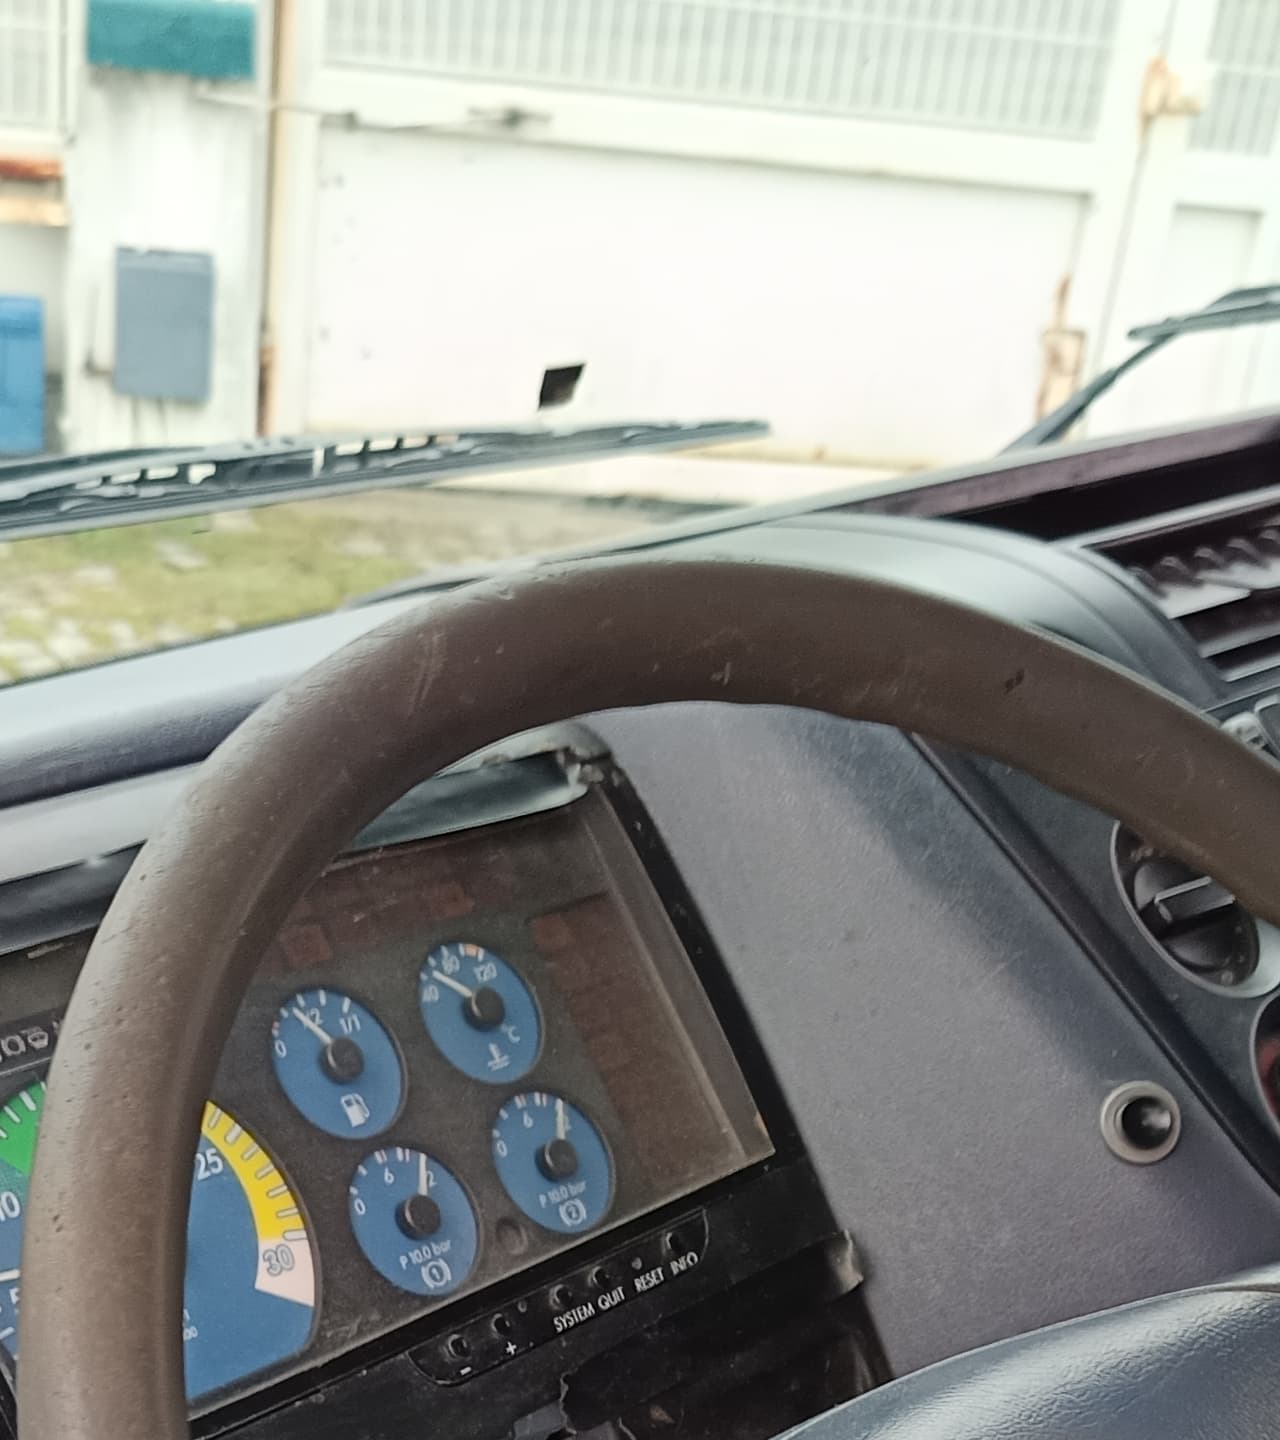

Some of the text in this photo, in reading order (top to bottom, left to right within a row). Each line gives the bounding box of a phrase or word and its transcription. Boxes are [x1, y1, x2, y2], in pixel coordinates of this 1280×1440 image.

[274, 1039, 287, 1058] 0
[496, 1139, 508, 1158] 0
[196, 1148, 224, 1181] 25
[383, 1167, 395, 1185] 6
[353, 1197, 366, 1216] 0
[431, 1240, 452, 1257] bar
[263, 1244, 296, 1277] 30
[553, 1302, 596, 1334] SYSTEM
[596, 1285, 626, 1312] QUIT
[633, 1266, 665, 1294] RESET
[669, 1251, 700, 1277] INFO
